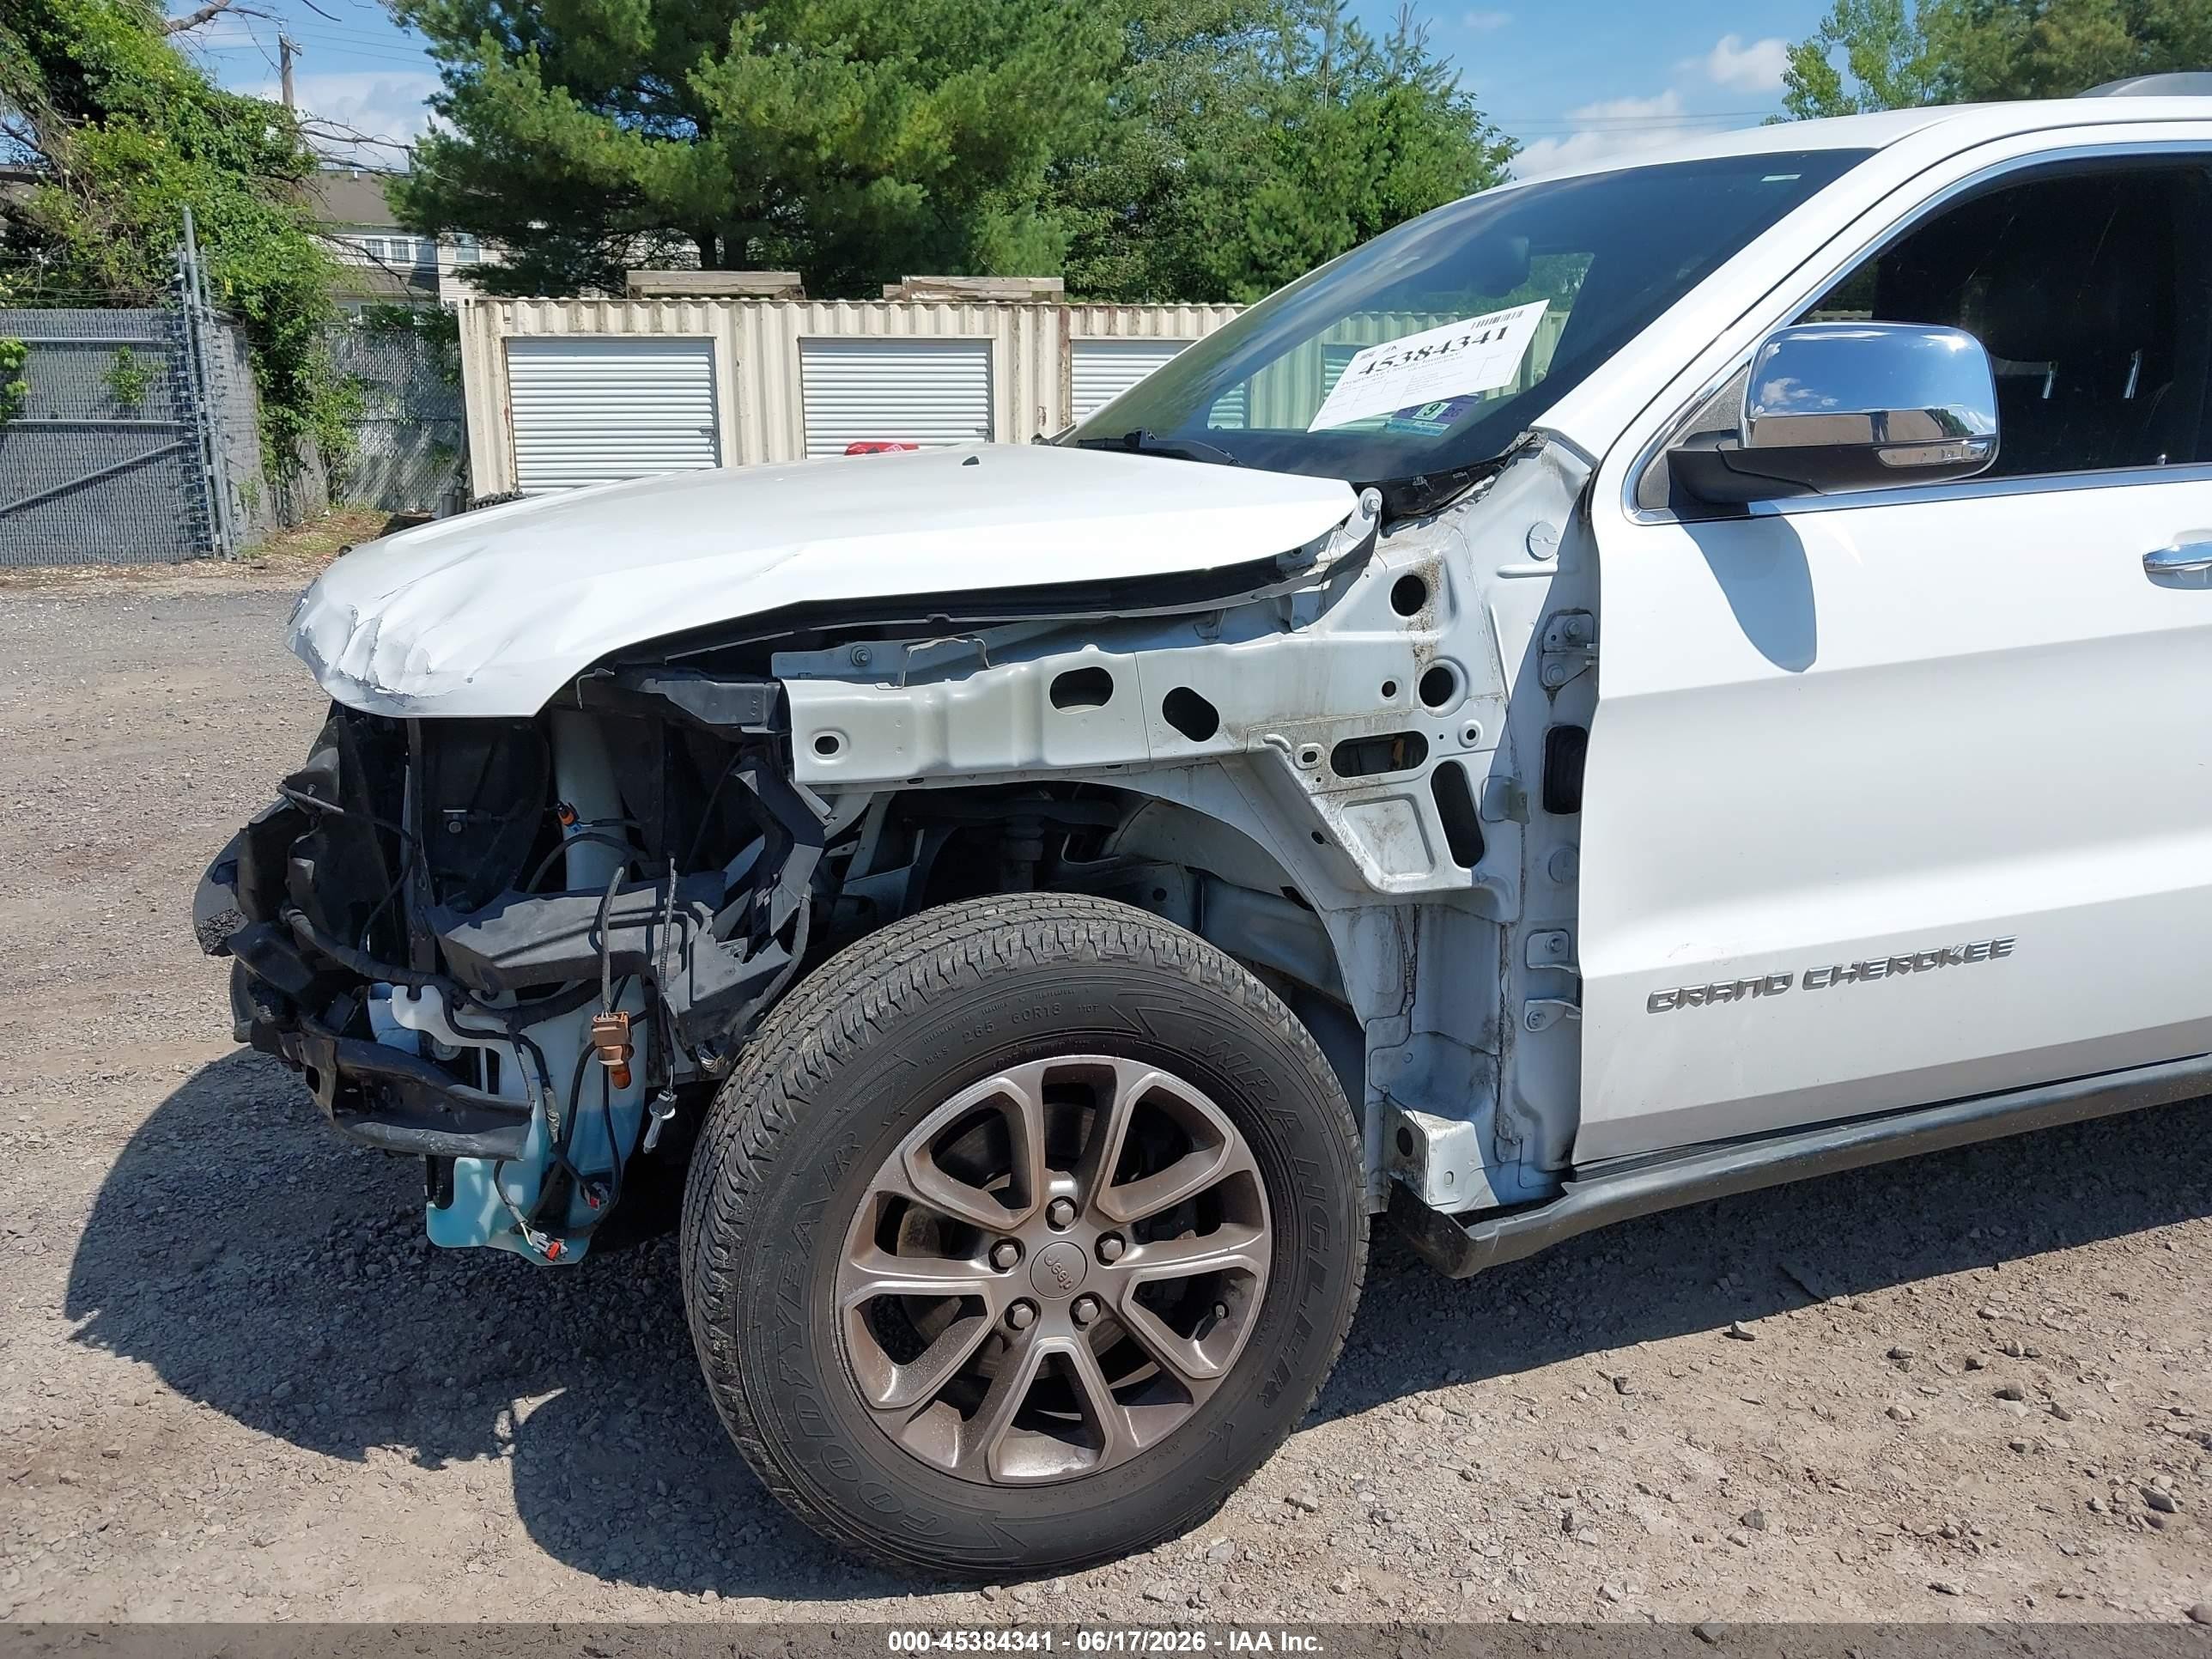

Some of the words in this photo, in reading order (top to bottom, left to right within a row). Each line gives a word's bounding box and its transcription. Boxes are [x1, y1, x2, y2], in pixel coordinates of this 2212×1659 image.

[1358, 325, 1509, 376] 45384341
[1424, 402, 1442, 416] 9
[1646, 970, 1794, 1014] GRAND
[1802, 934, 2018, 991] CHEROKEE
[1188, 1027, 1332, 1408] WRANGLER
[1043, 1254, 1073, 1290] Jeep
[774, 1130, 954, 1537] GOODYEAR
